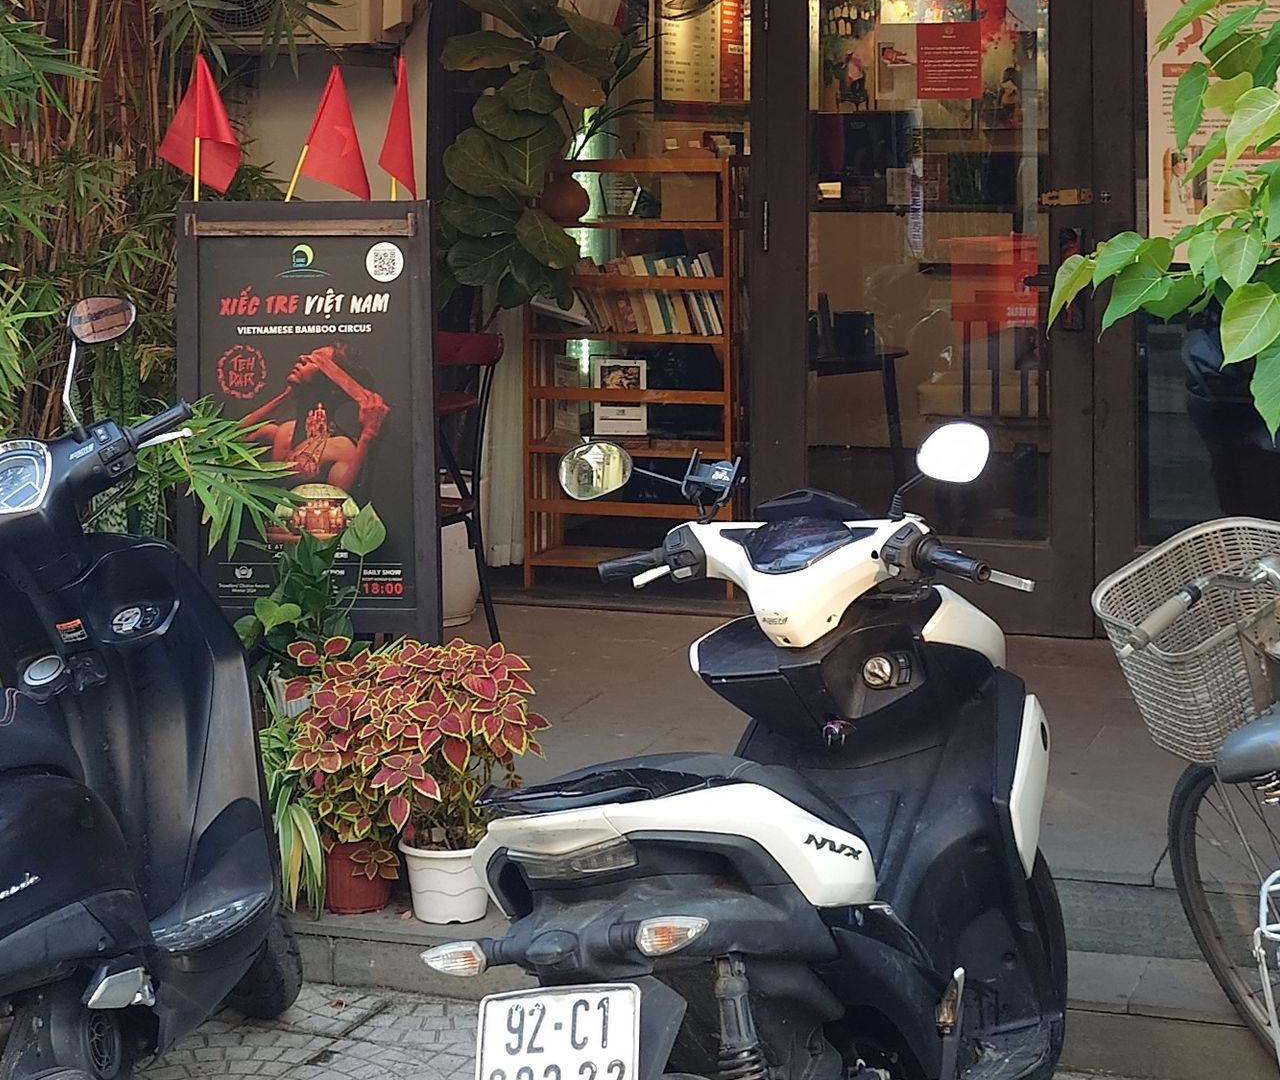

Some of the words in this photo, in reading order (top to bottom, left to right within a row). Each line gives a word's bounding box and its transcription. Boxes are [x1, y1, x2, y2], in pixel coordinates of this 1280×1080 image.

[220, 285, 261, 316] XIẾC
[265, 293, 300, 314] TRE
[304, 287, 345, 319] VIỆT
[350, 292, 390, 314] NAM
[237, 325, 294, 335] VIETNAMESE
[295, 324, 337, 334] BAMBOO
[338, 323, 372, 333] CIRCUS
[363, 582, 403, 594] 18:00
[803, 833, 862, 860] NVX
